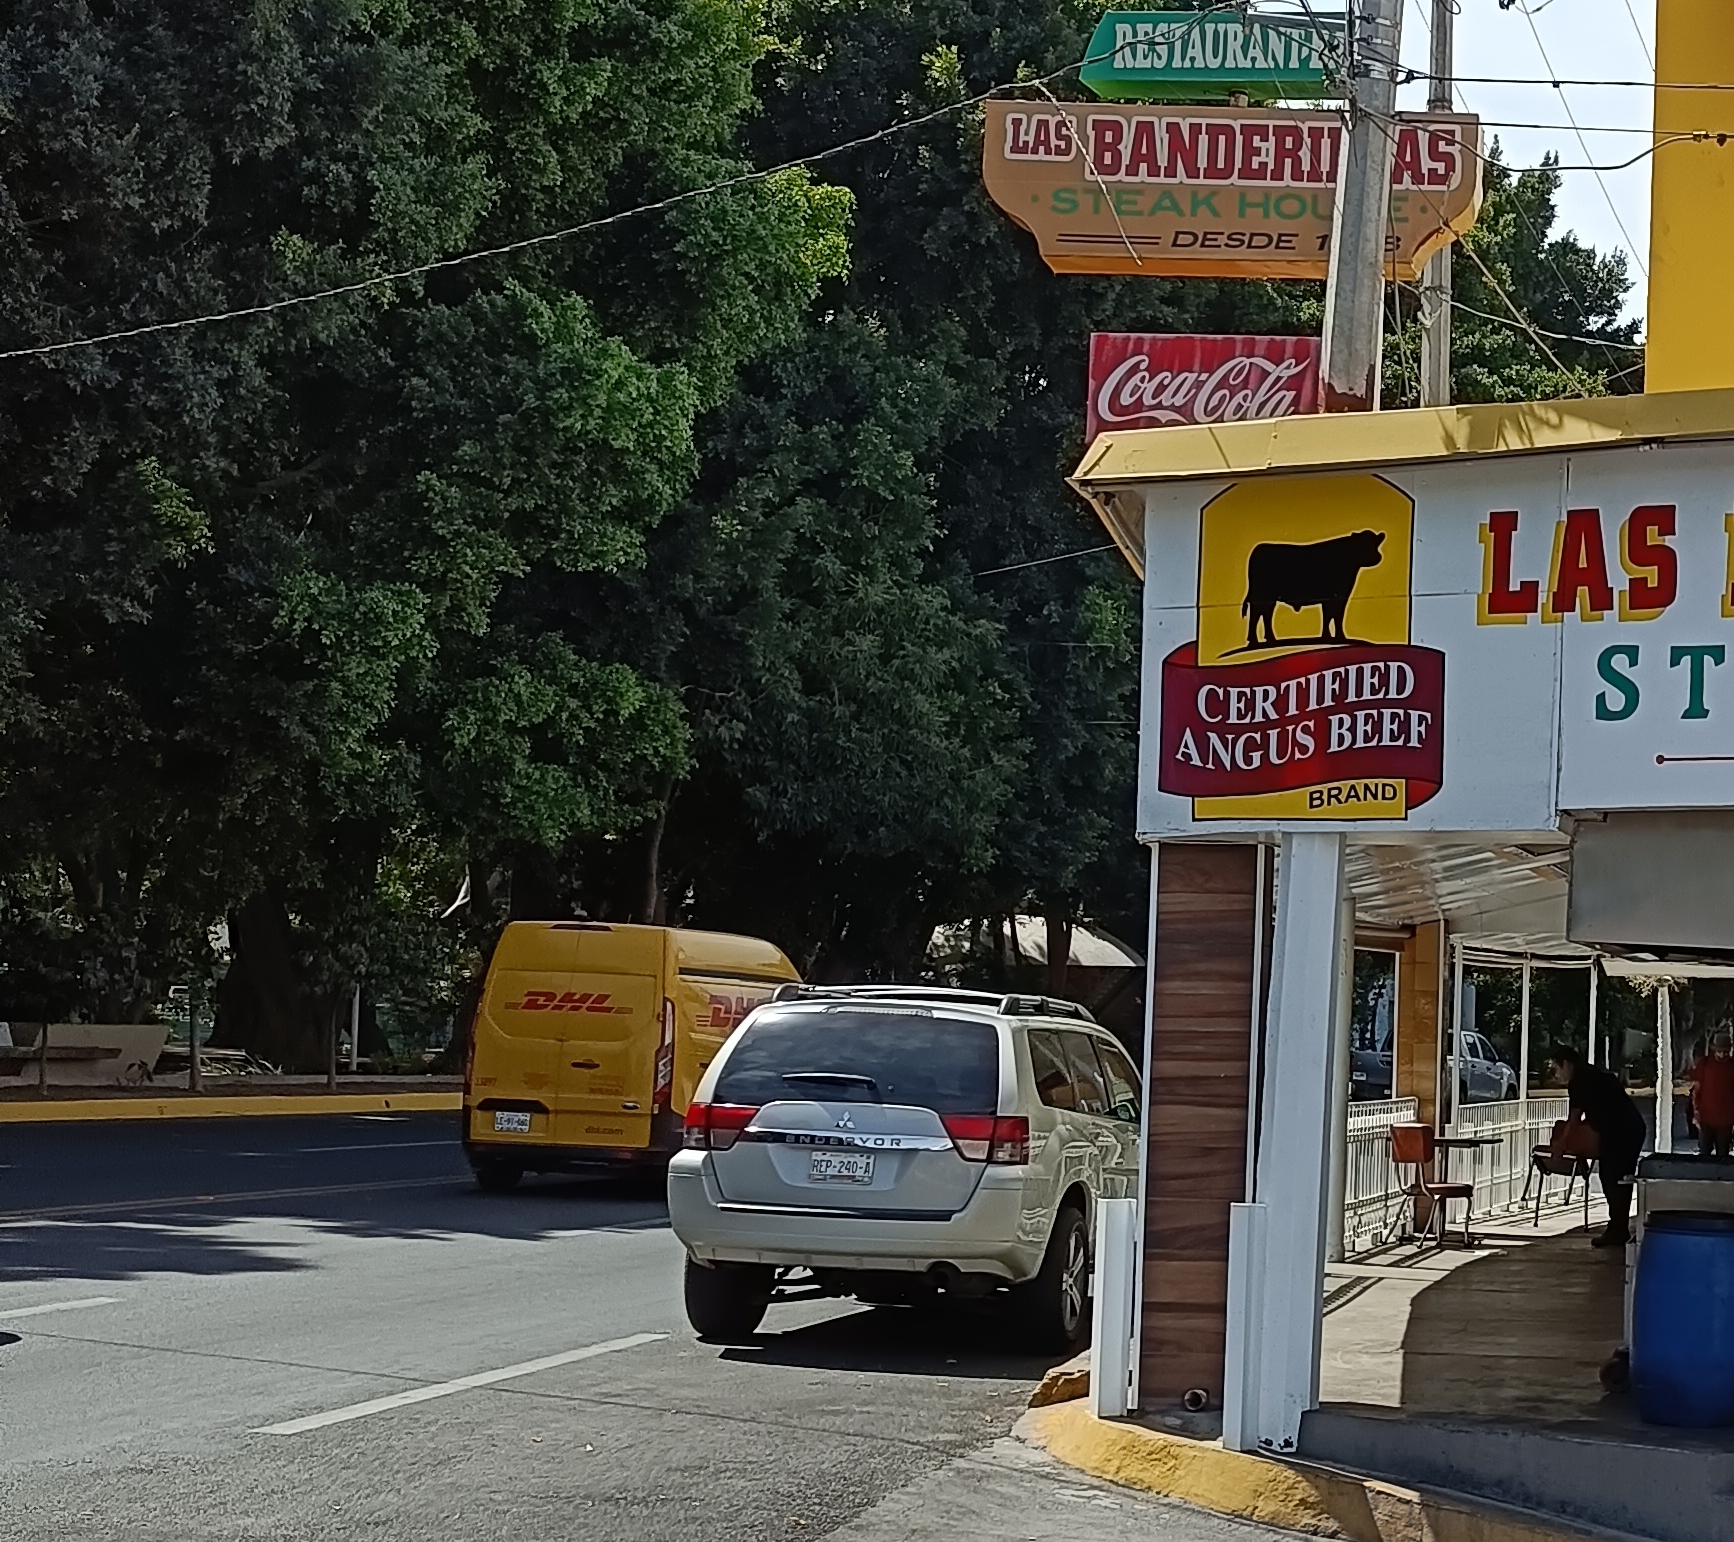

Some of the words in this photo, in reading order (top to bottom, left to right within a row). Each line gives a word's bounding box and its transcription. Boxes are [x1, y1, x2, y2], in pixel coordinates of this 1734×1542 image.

[1009, 117, 1074, 157] LAS
[1089, 118, 1456, 187] BANDERIAS
[1051, 187, 1222, 219] STEAK
[1170, 230, 1300, 250] DESDE
[1097, 354, 1312, 425] Coca-Cola
[1477, 504, 1678, 626] LAS
[1197, 661, 1415, 724] CERTIFIED
[1175, 718, 1316, 772] ANGUS
[1327, 707, 1432, 754] BEEF
[1308, 781, 1398, 811] BRAND
[516, 990, 617, 1014] DHL
